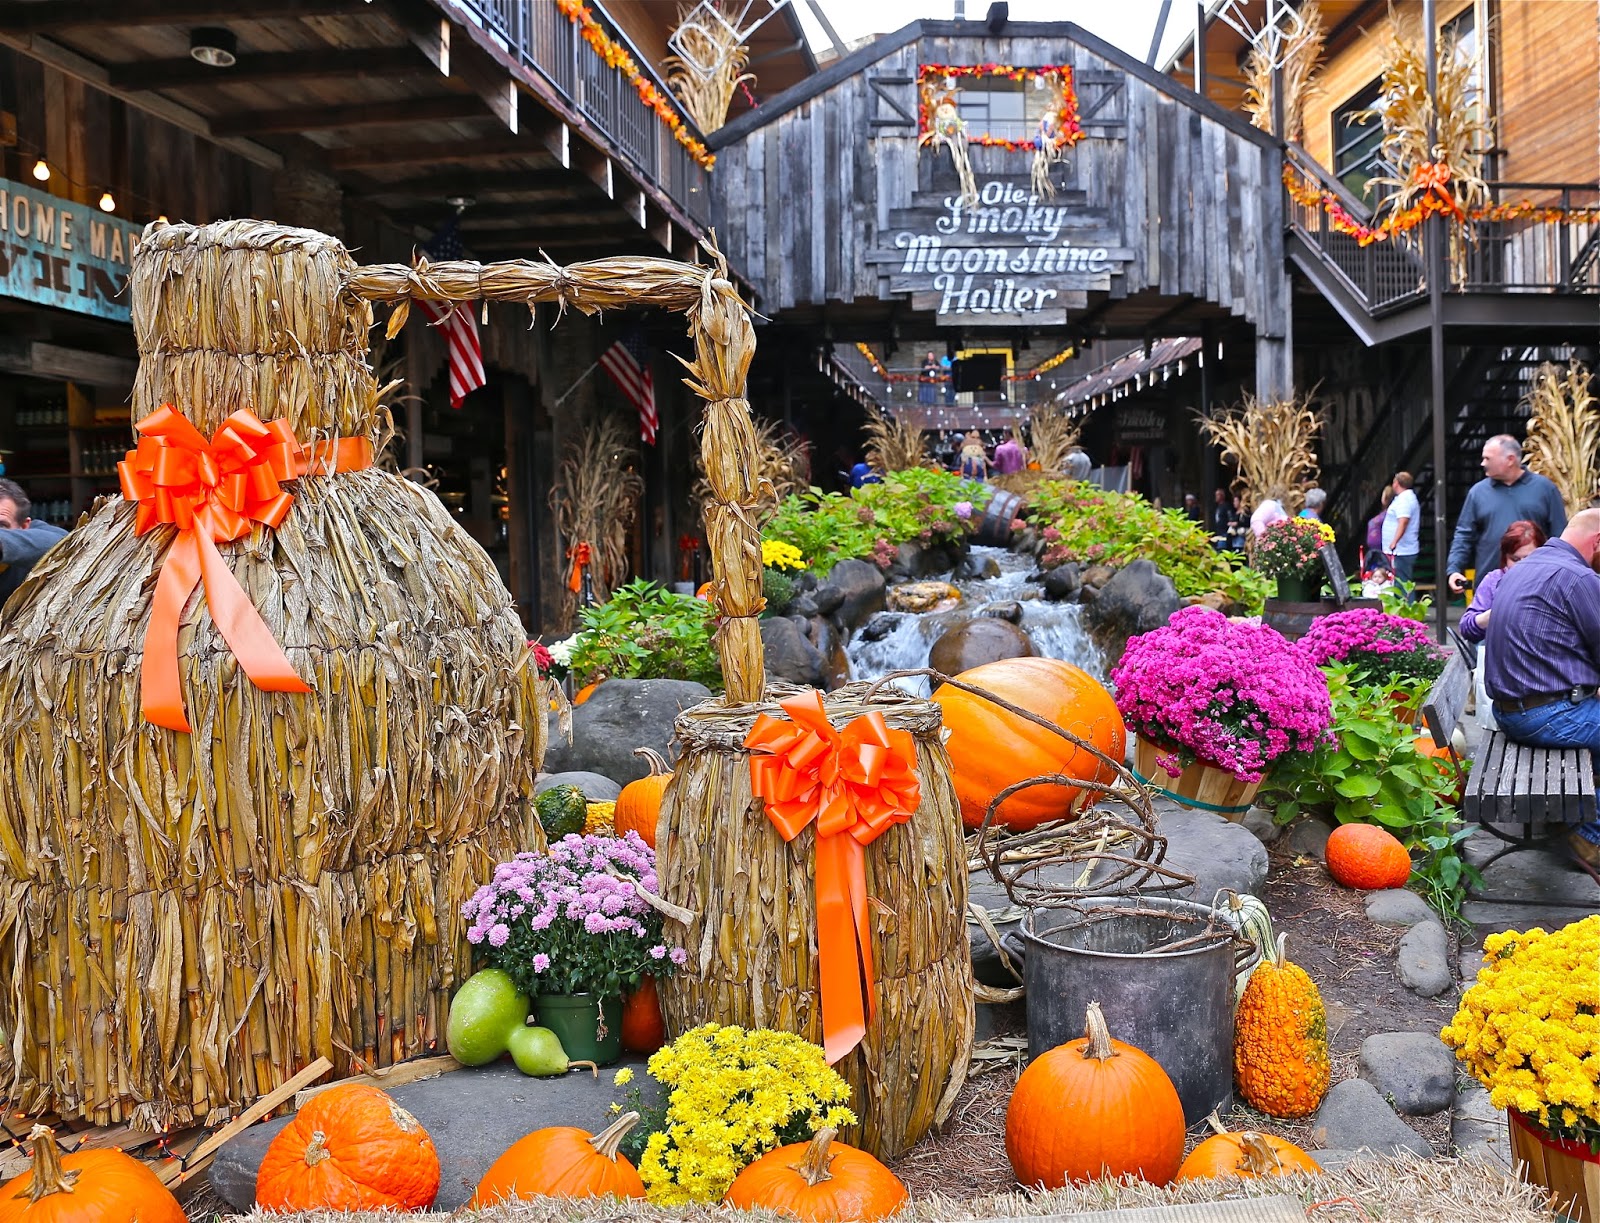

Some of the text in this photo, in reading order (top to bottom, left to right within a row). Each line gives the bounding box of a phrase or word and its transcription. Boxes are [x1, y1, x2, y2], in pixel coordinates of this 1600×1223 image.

[981, 181, 1029, 205] Ole
[936, 193, 1068, 243] Smoky
[895, 231, 1115, 274] Moonshine
[933, 273, 1058, 315] Holler
